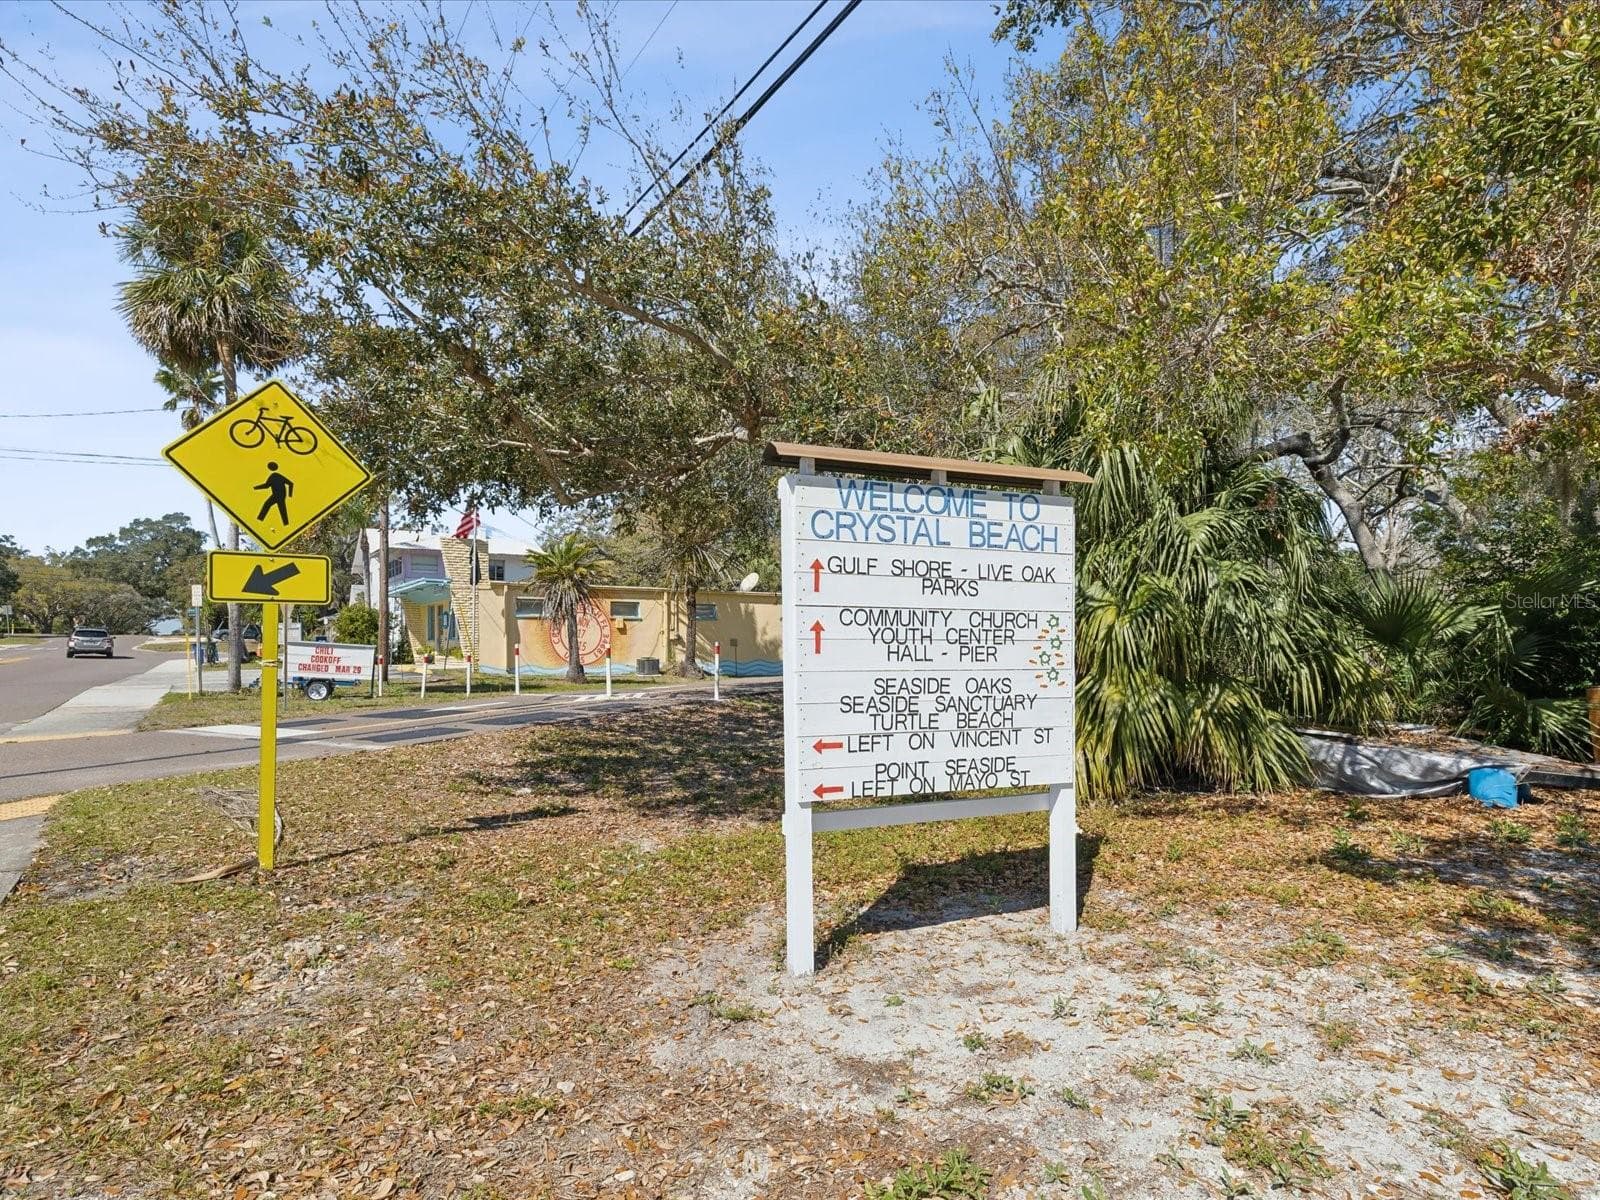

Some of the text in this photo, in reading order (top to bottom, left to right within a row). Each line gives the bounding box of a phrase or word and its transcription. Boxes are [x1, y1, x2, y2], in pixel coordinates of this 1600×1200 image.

[836, 478, 1041, 521] WELCOME TO
[810, 509, 1058, 553] CRYSTAL BEACH
[827, 555, 878, 576] GULF
[891, 559, 952, 579] SHORE
[978, 563, 1013, 582] LIVE
[1021, 565, 1056, 583] OAK
[922, 578, 979, 597] PARKS
[839, 608, 1038, 629] COMMUNITY CHURCH
[868, 627, 1015, 646] YOUTH CENTER
[311, 655, 342, 664] COOKOFF
[315, 645, 334, 655] CHILI
[887, 645, 933, 662] HALL
[959, 645, 998, 663] PIER
[298, 663, 329, 672] CHANGED
[335, 665, 351, 673] MAR
[873, 677, 1012, 695] SEASIDE OAKS
[839, 694, 1038, 714] SEASIDE SANCTUARY
[869, 711, 1014, 731] TURTLE BEACH
[847, 728, 1053, 753] LEFT ON VINCENT ST
[875, 756, 1016, 780] POINT SEASIDE
[851, 770, 1030, 799] LEFT ON MAYO ST
